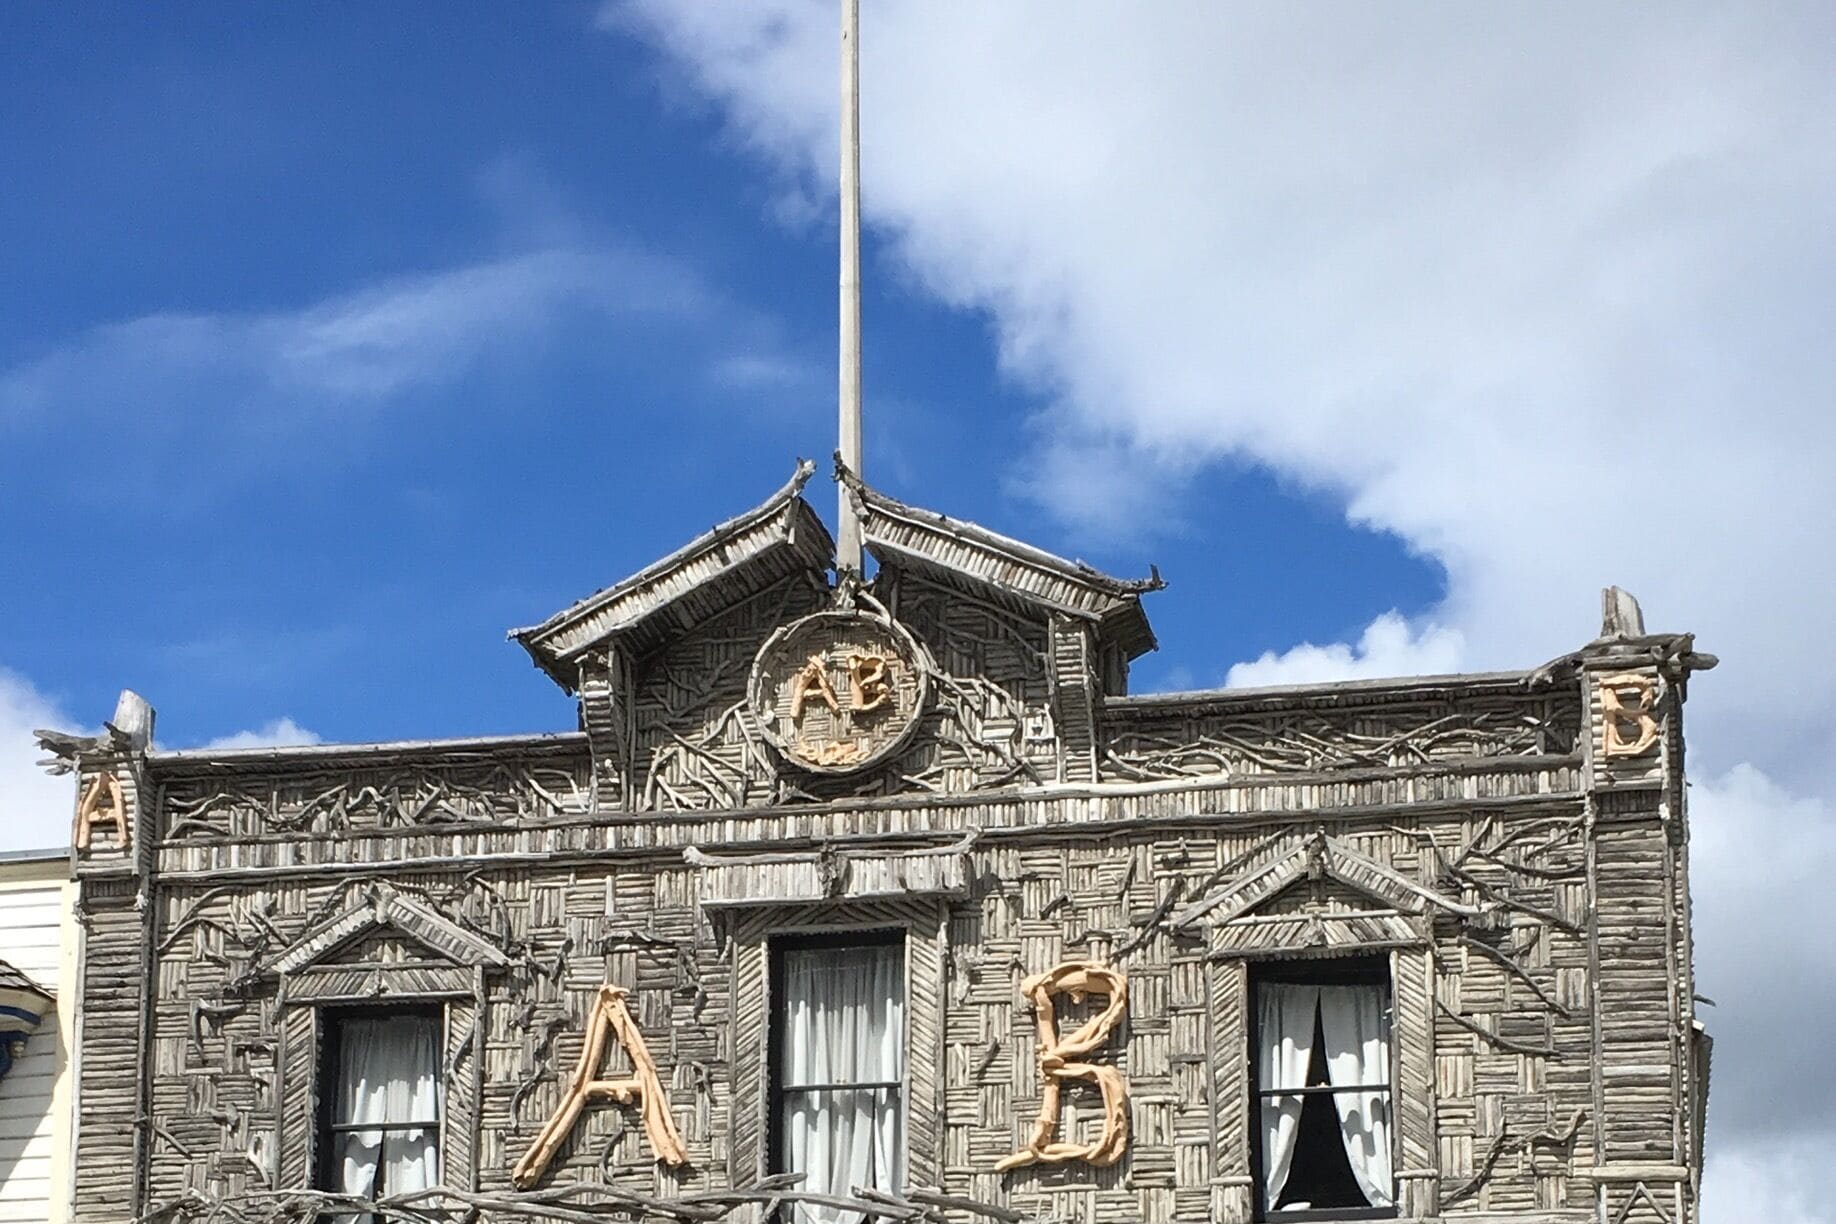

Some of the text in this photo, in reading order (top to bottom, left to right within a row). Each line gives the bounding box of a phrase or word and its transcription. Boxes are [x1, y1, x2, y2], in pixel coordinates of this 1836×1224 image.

[1599, 674, 1657, 755] B
[76, 769, 127, 849] A
[512, 960, 1128, 1189] A B
